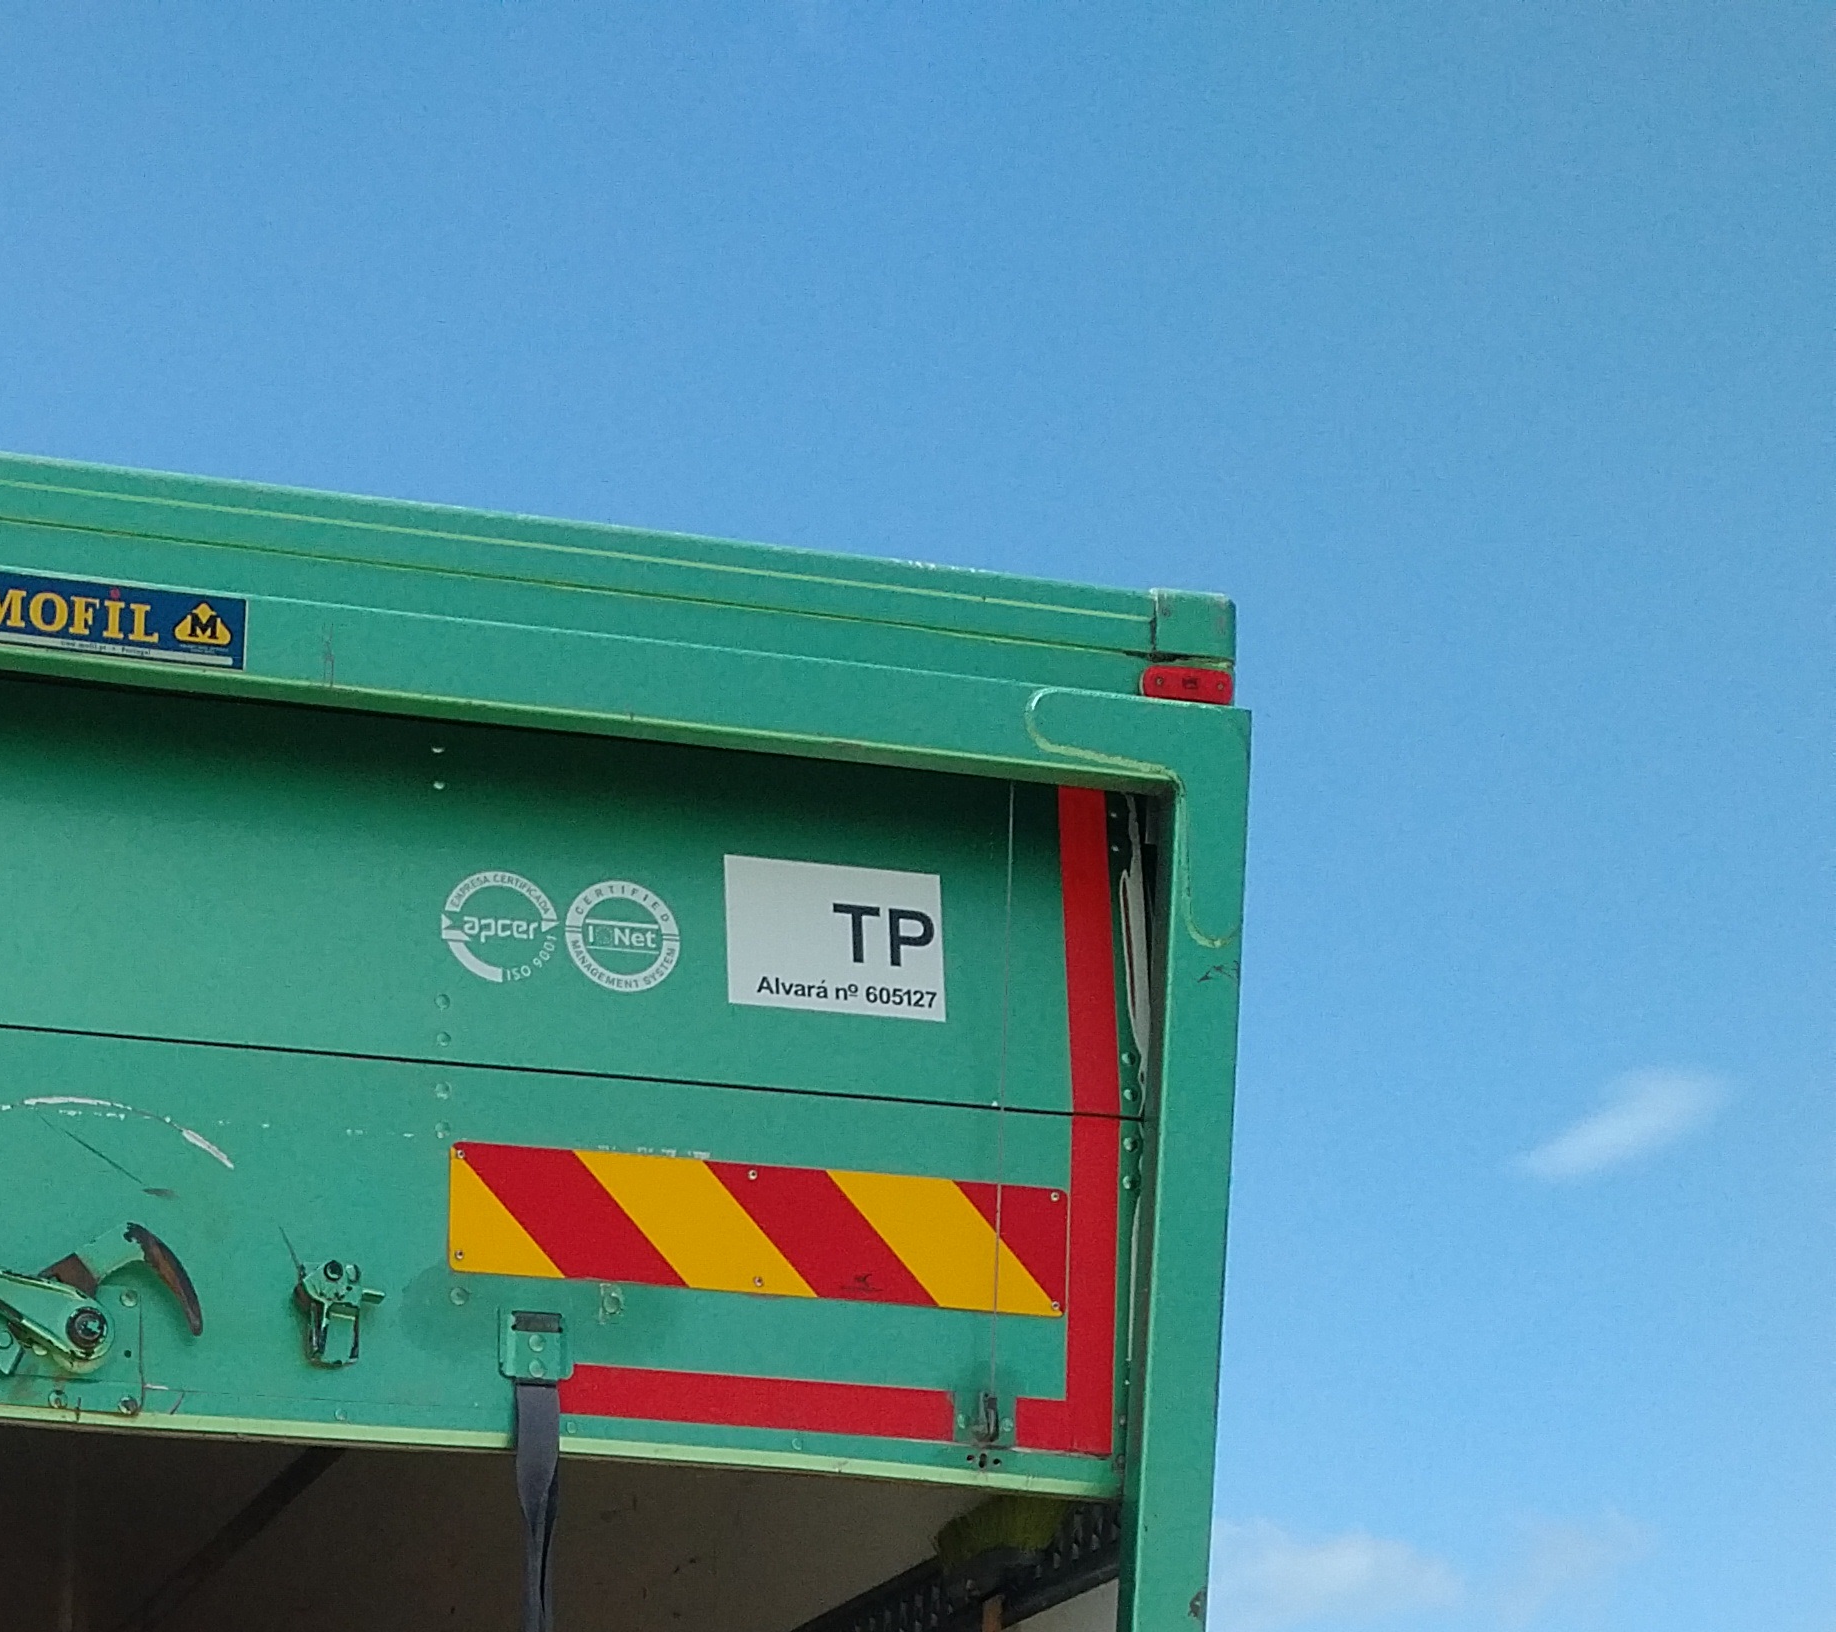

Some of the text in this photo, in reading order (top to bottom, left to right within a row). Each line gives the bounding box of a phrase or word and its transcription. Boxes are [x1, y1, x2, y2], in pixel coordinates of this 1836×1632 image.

[450, 873, 551, 914] EMPRESA CERTIFICADA
[574, 885, 670, 922] CERTIFIED
[463, 916, 539, 943] apcer
[832, 902, 935, 967] TP
[506, 935, 558, 981] ISO 9001
[571, 939, 677, 989] MANAGEMENT SYSTEM
[756, 976, 829, 999] Alvará
[865, 986, 938, 1009] 605127
